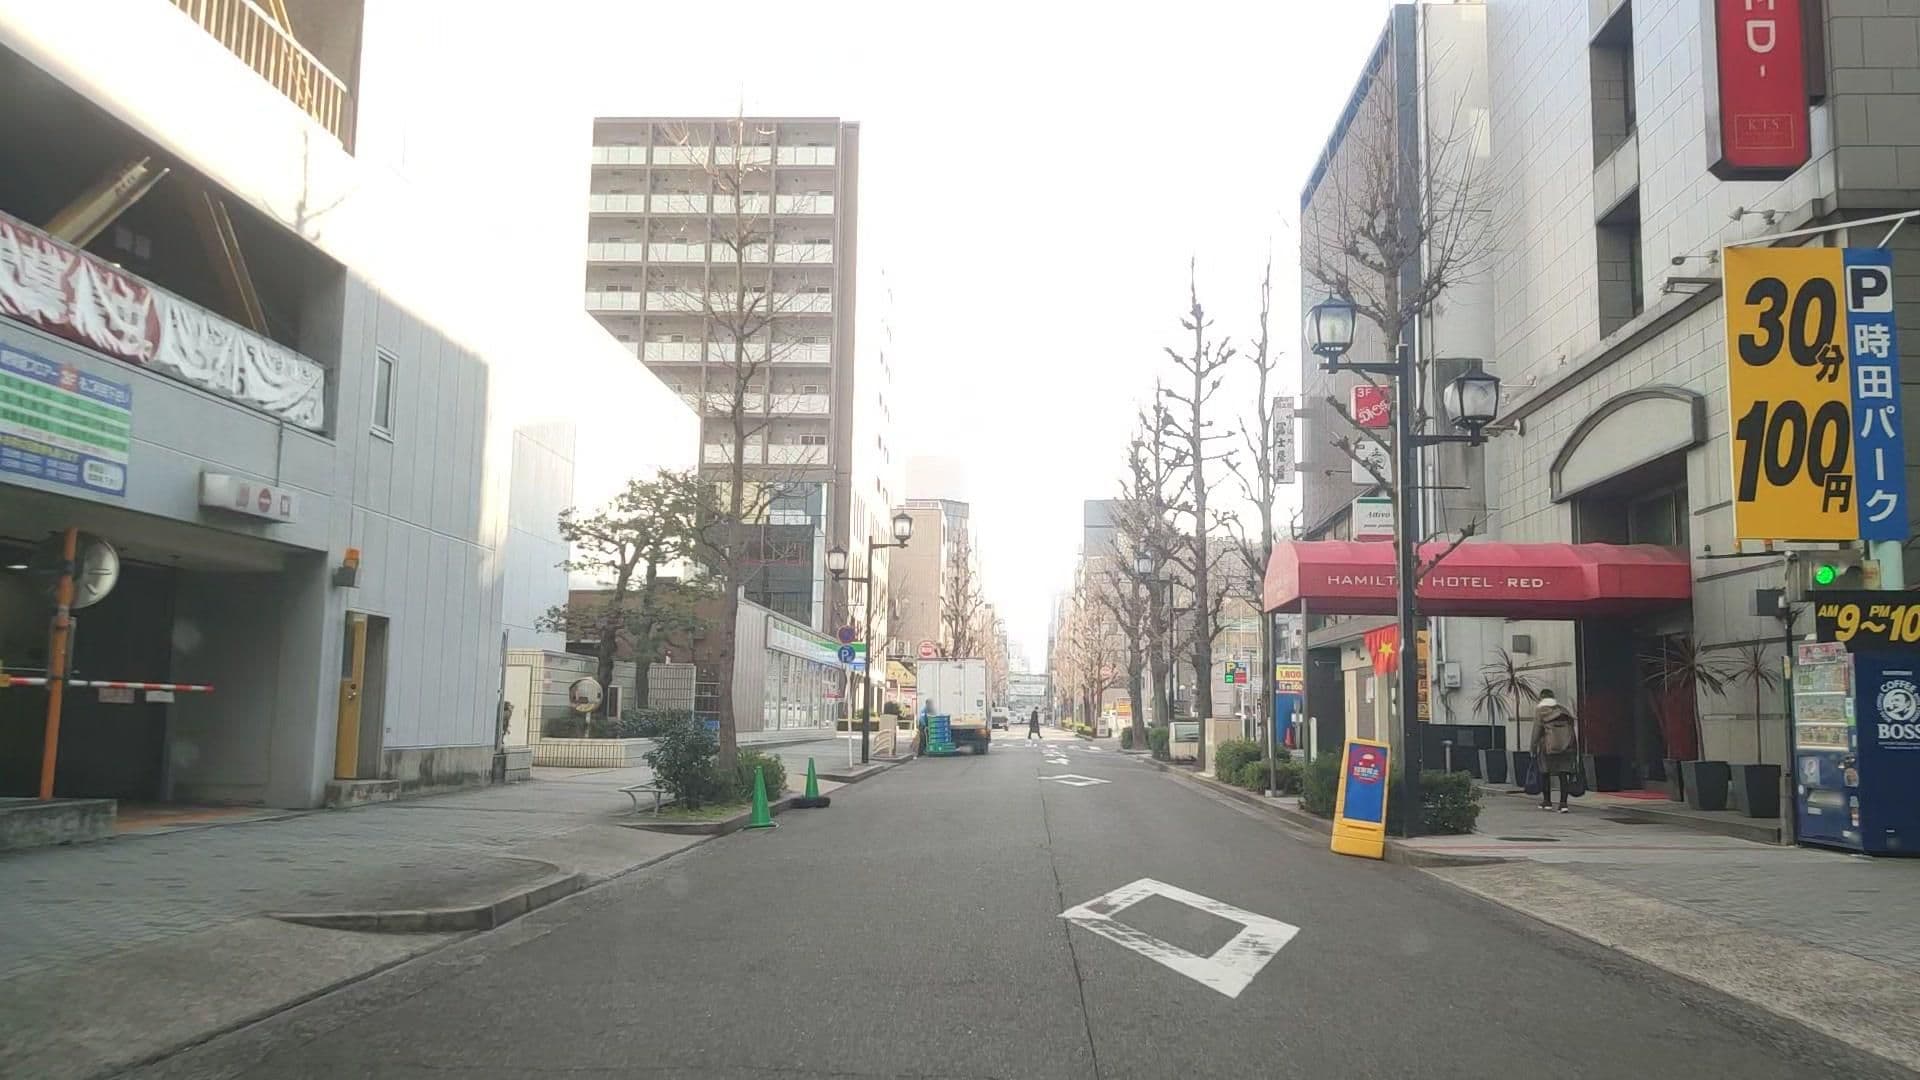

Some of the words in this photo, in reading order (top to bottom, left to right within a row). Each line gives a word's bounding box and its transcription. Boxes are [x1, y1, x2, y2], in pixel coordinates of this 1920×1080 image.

[1854, 324, 1898, 523] 時田パーク
[1432, 576, 1493, 588] HOTEL
[1880, 680, 1917, 693] COFFEE
